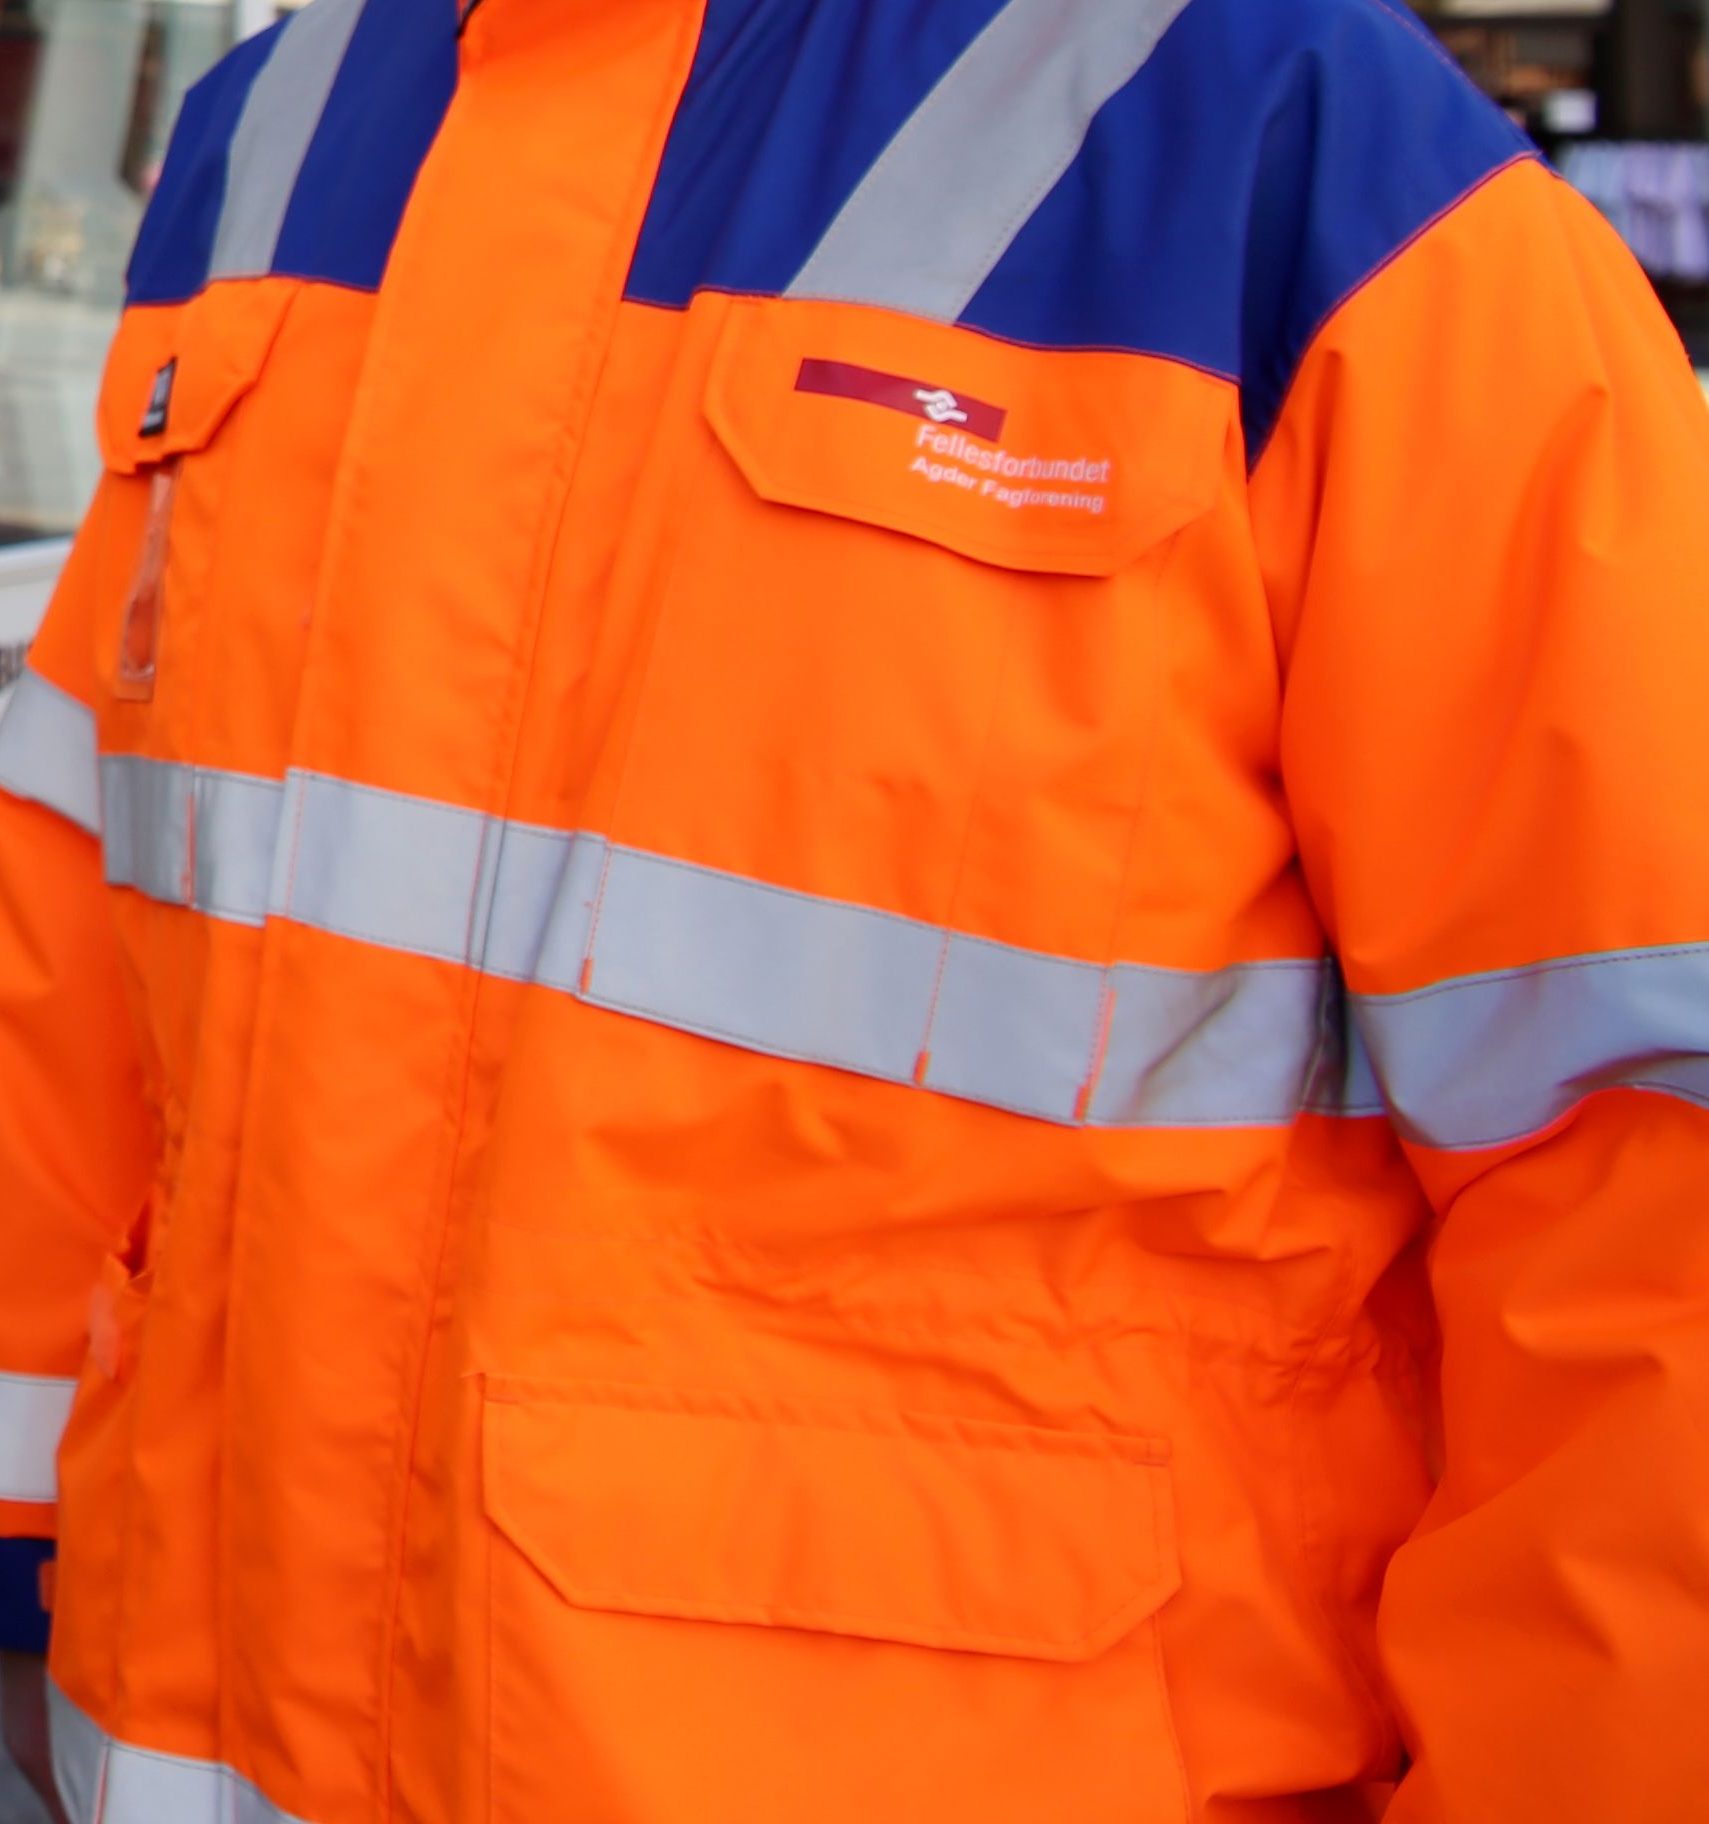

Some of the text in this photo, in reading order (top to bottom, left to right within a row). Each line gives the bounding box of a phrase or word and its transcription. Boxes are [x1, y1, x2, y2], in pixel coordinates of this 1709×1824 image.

[914, 423, 1111, 484] Fellesforbundet
[911, 455, 1105, 515] Agder Fagforening
